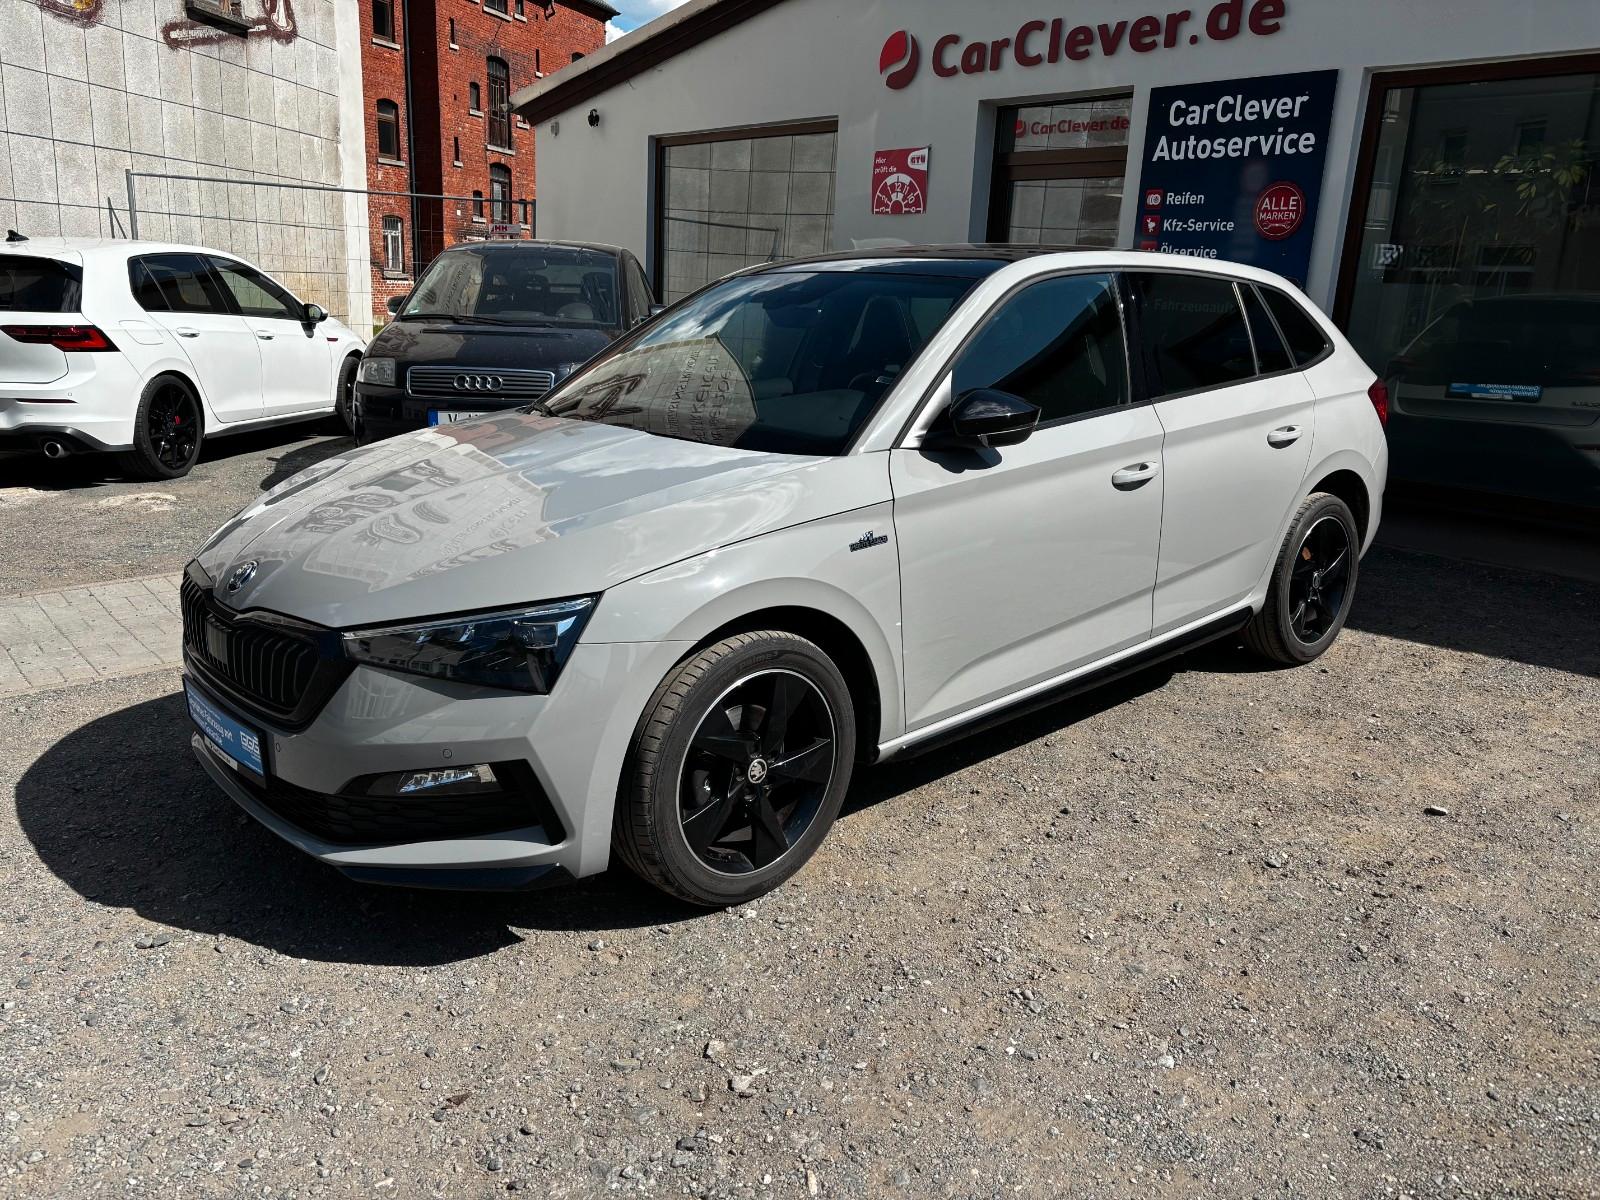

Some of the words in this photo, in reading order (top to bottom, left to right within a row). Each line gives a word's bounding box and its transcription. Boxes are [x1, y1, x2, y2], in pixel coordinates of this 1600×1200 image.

[931, 0, 1286, 78] CarClever.de
[1169, 94, 1310, 127] CarClever
[1030, 116, 1130, 136] CarClever.de
[1152, 127, 1316, 162] Autoservice
[1166, 191, 1205, 205] Reifen
[1261, 196, 1299, 210] ALLE
[1259, 211, 1297, 221] MARKEN
[1163, 218, 1235, 232] Kfz-Service
